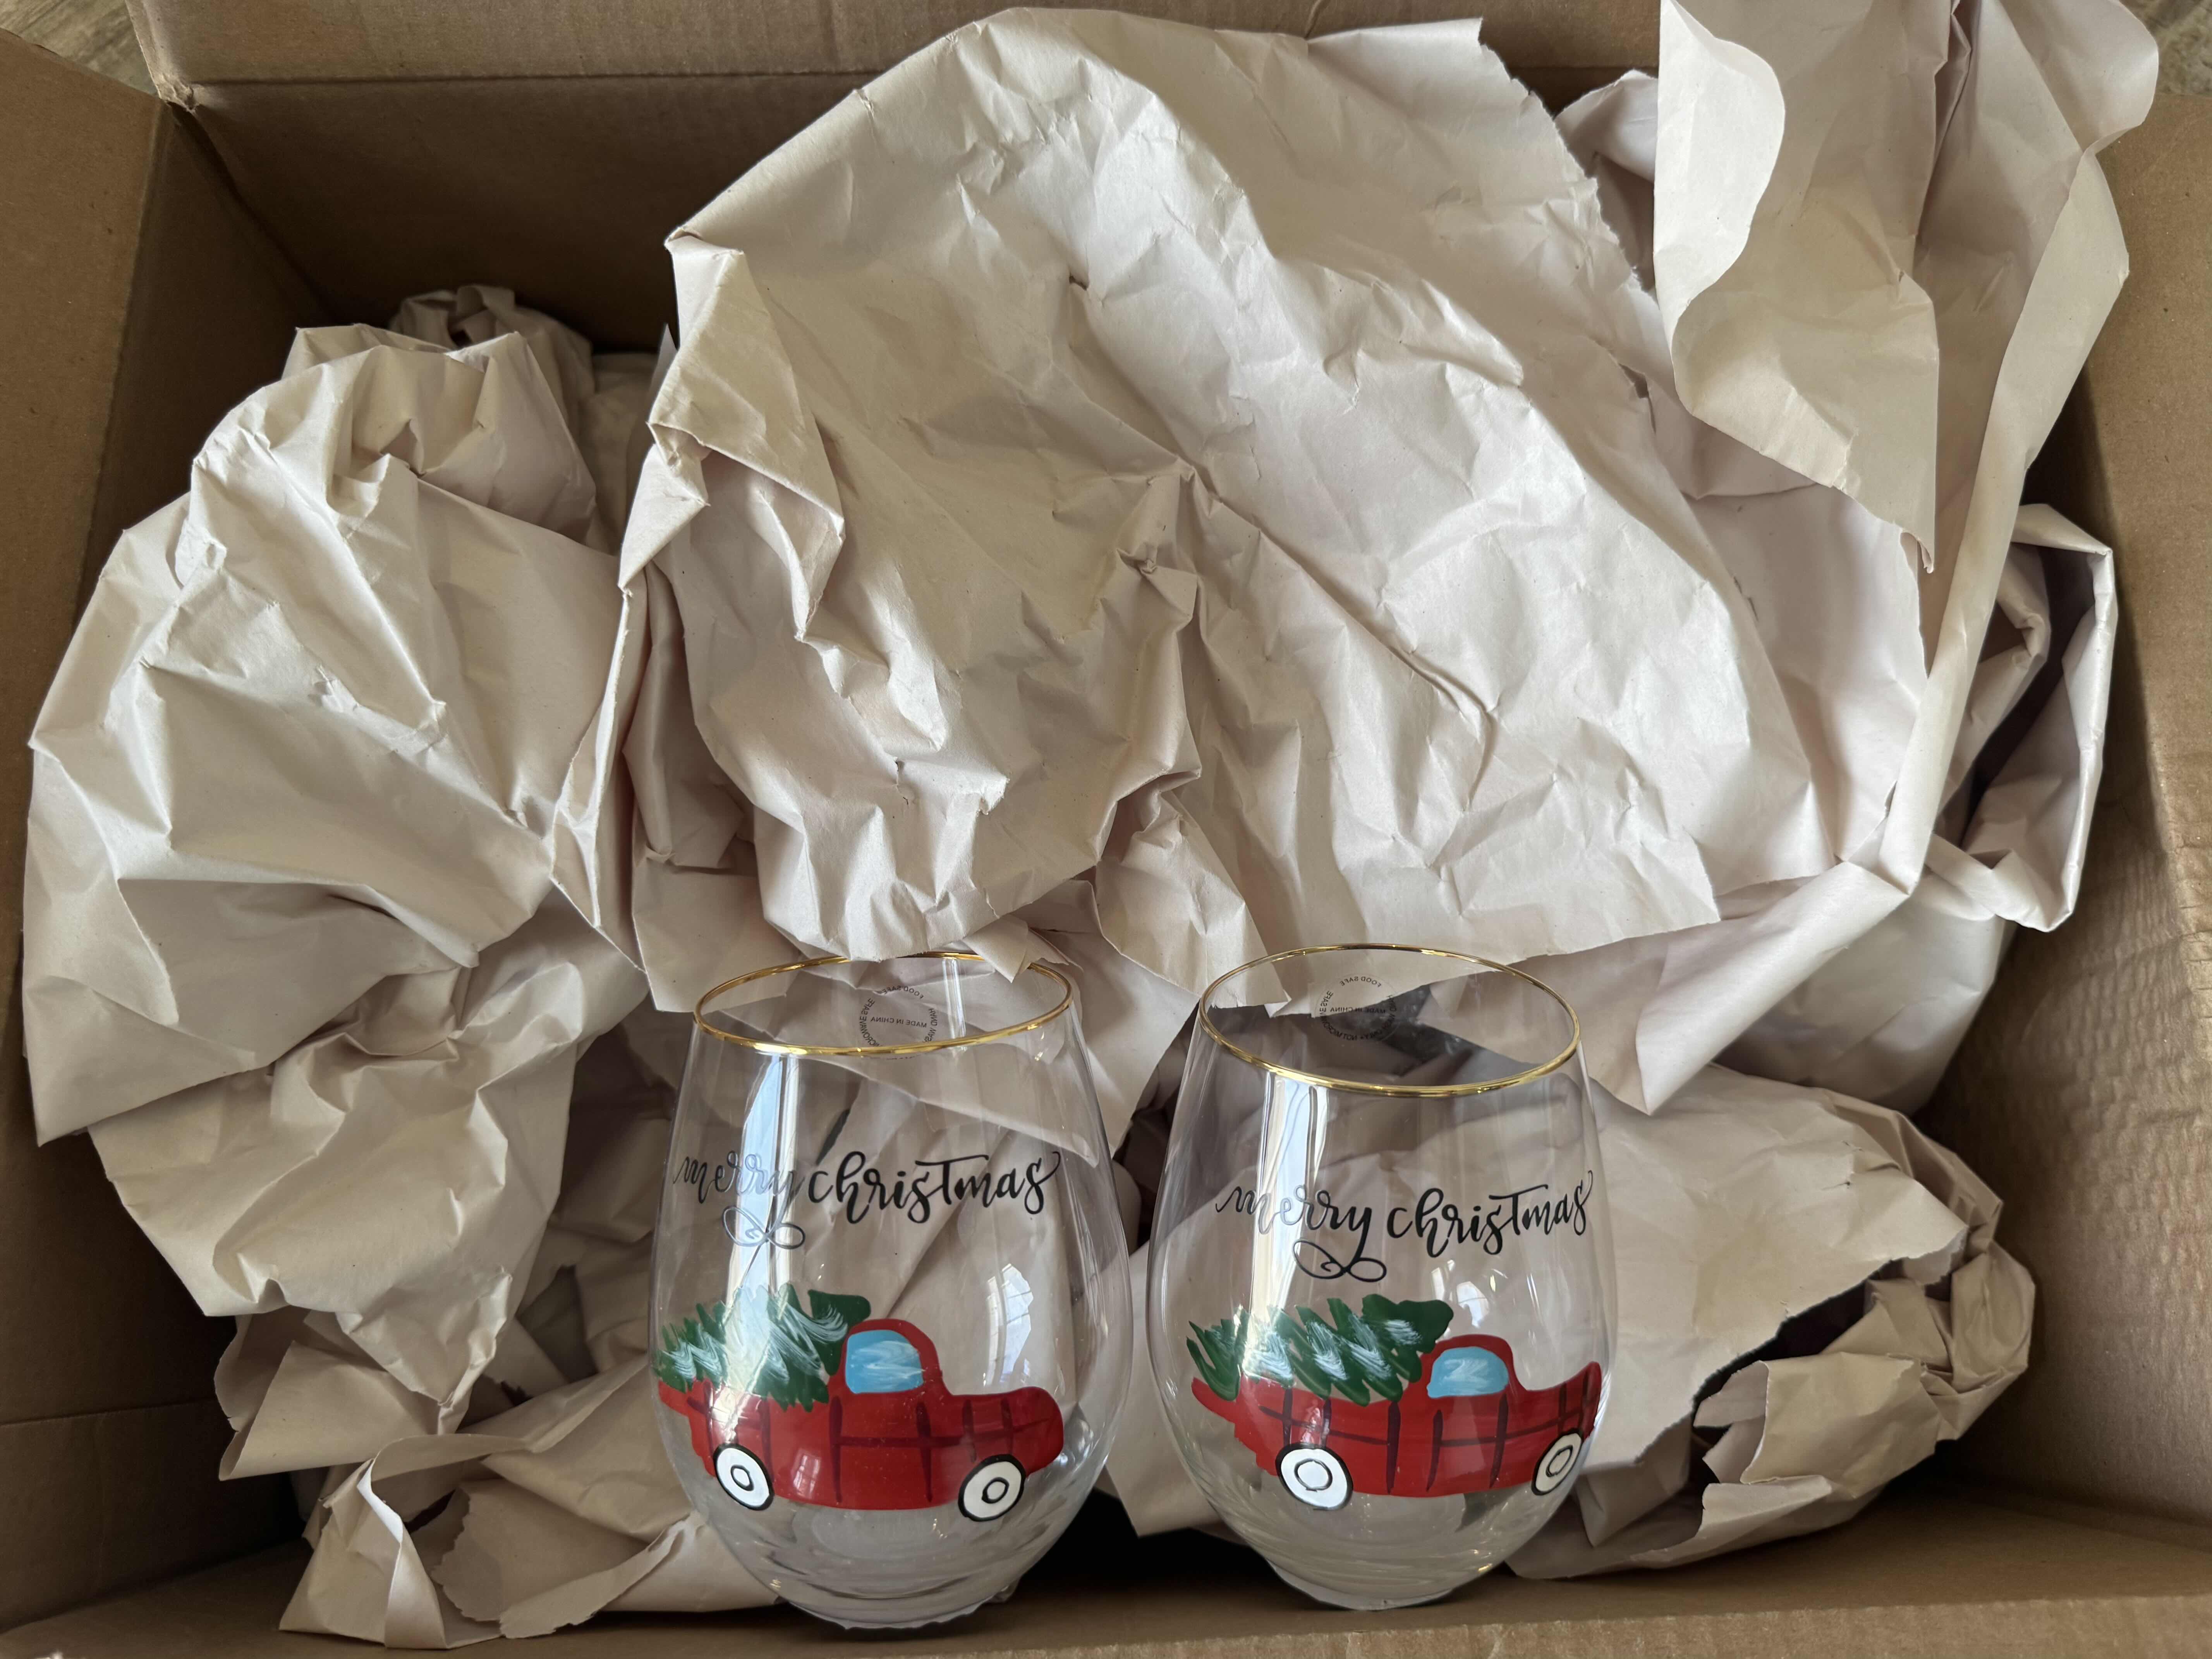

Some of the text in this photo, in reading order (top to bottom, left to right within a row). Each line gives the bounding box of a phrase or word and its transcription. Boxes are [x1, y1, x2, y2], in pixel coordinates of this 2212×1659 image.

[807, 1150, 1061, 1224] christmas
[1214, 1170, 1594, 1283] merry christmas
